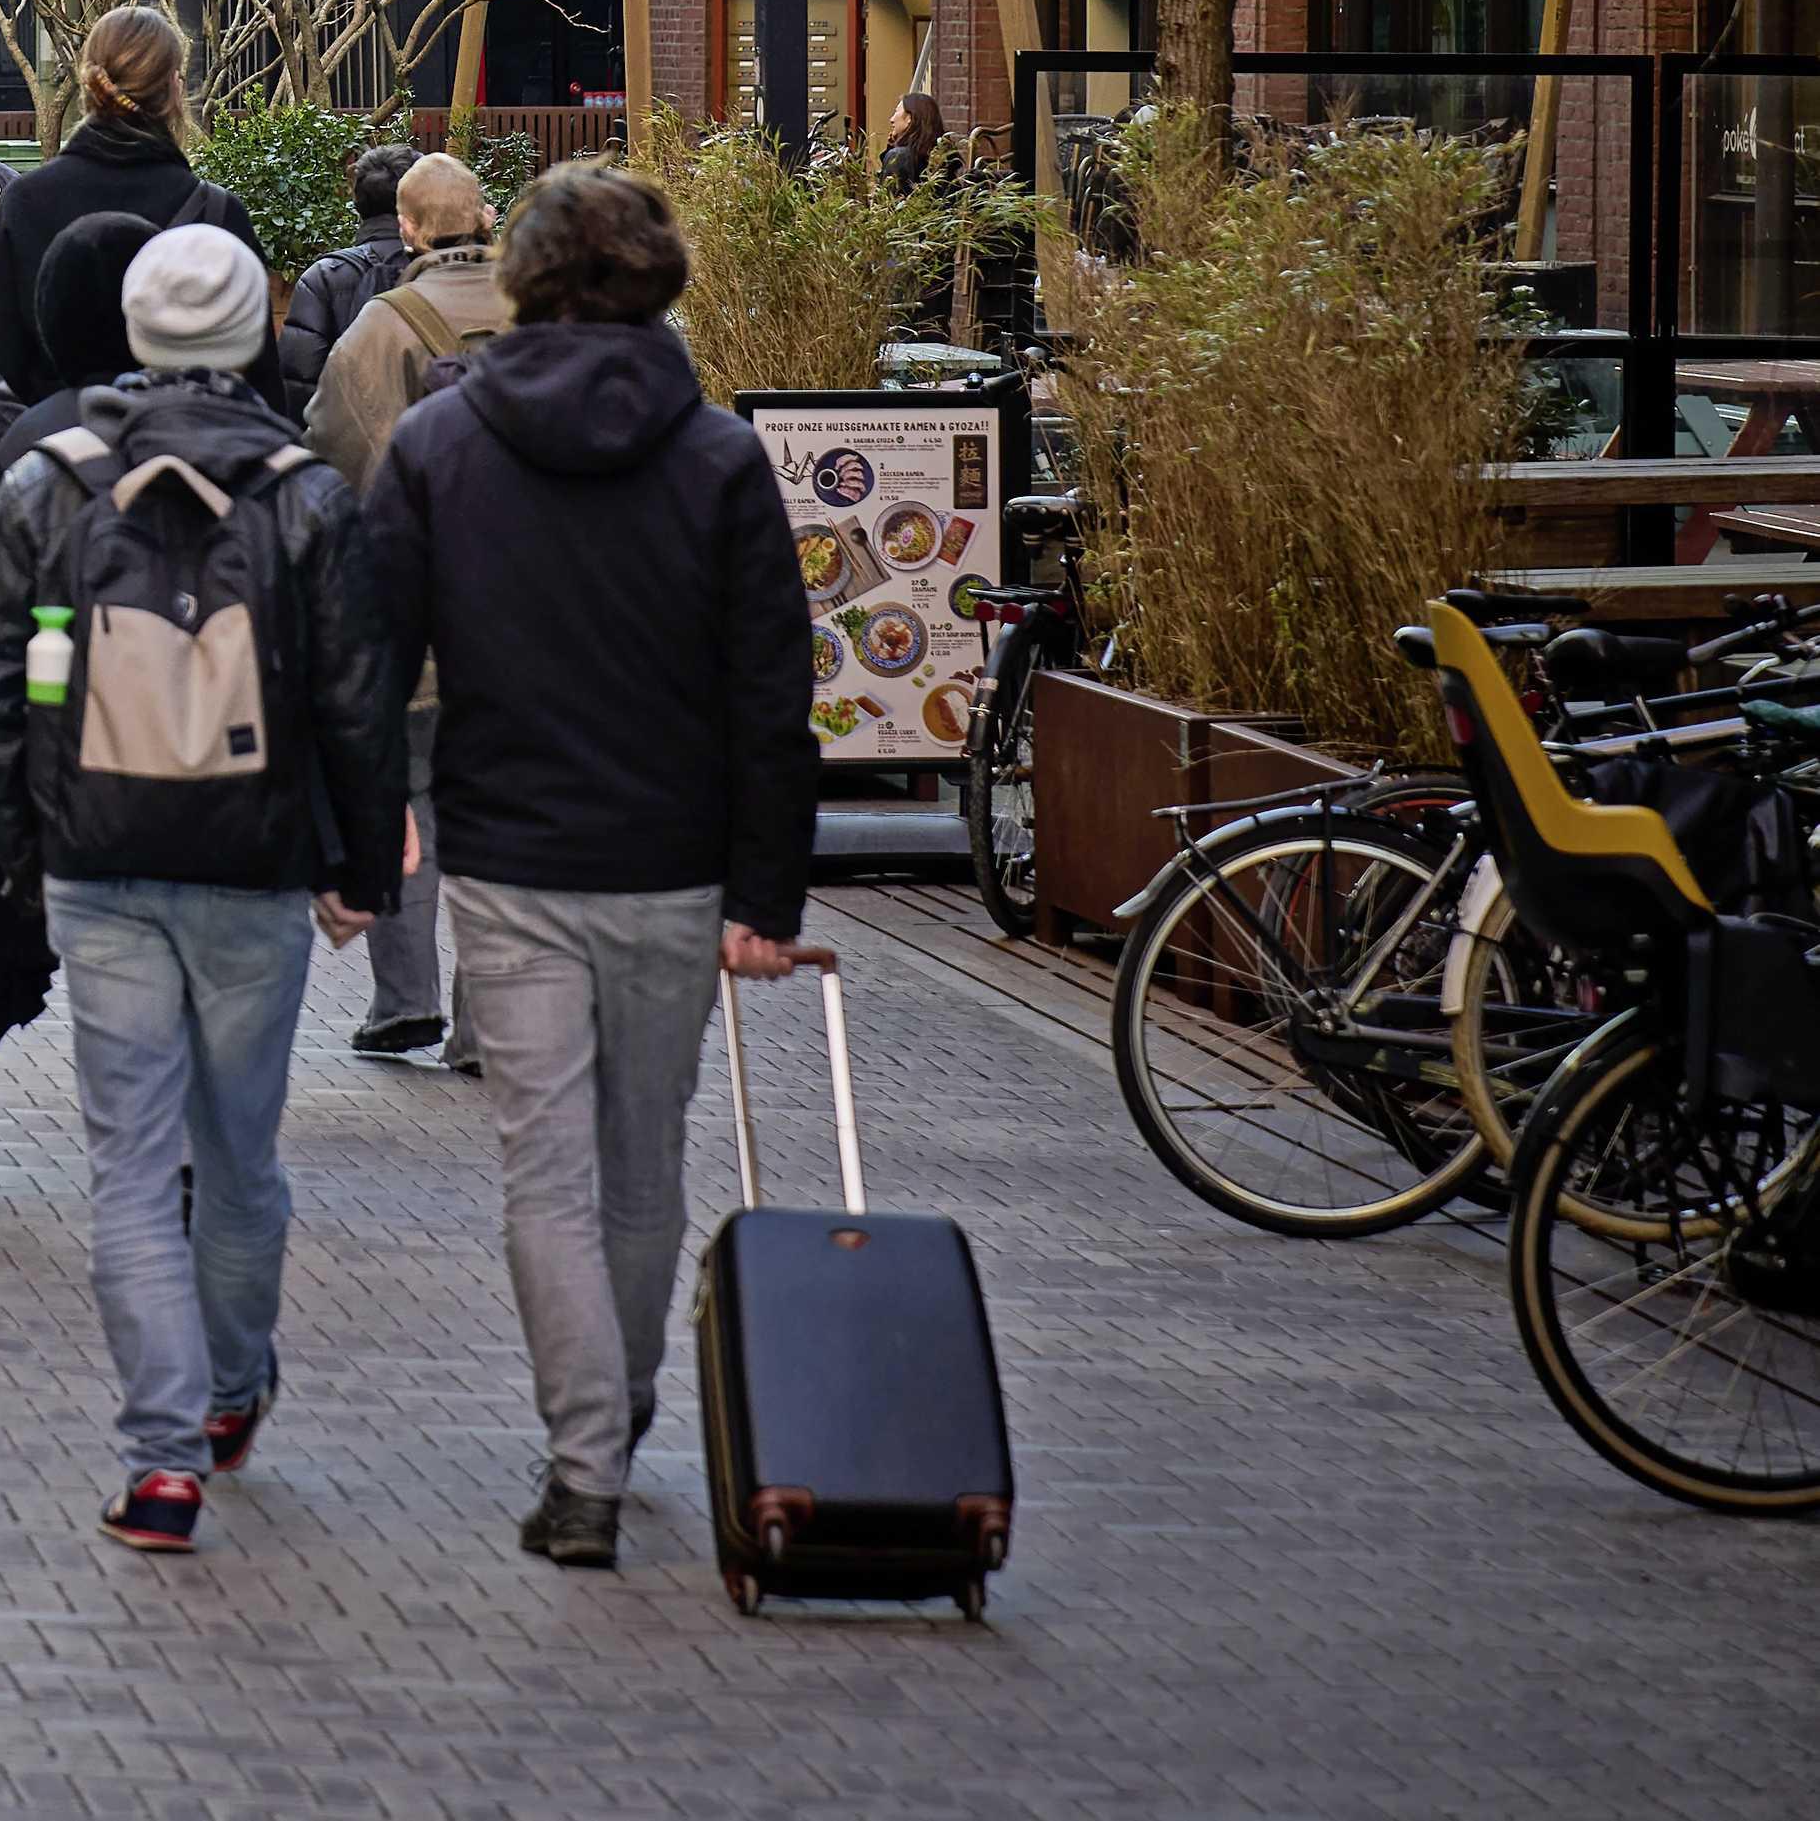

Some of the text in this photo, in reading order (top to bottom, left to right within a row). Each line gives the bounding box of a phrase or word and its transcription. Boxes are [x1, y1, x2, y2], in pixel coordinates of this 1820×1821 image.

[765, 421, 989, 432] PROEF ONZE HUISGEMAAKTE RAMEN & GYOZA!!
